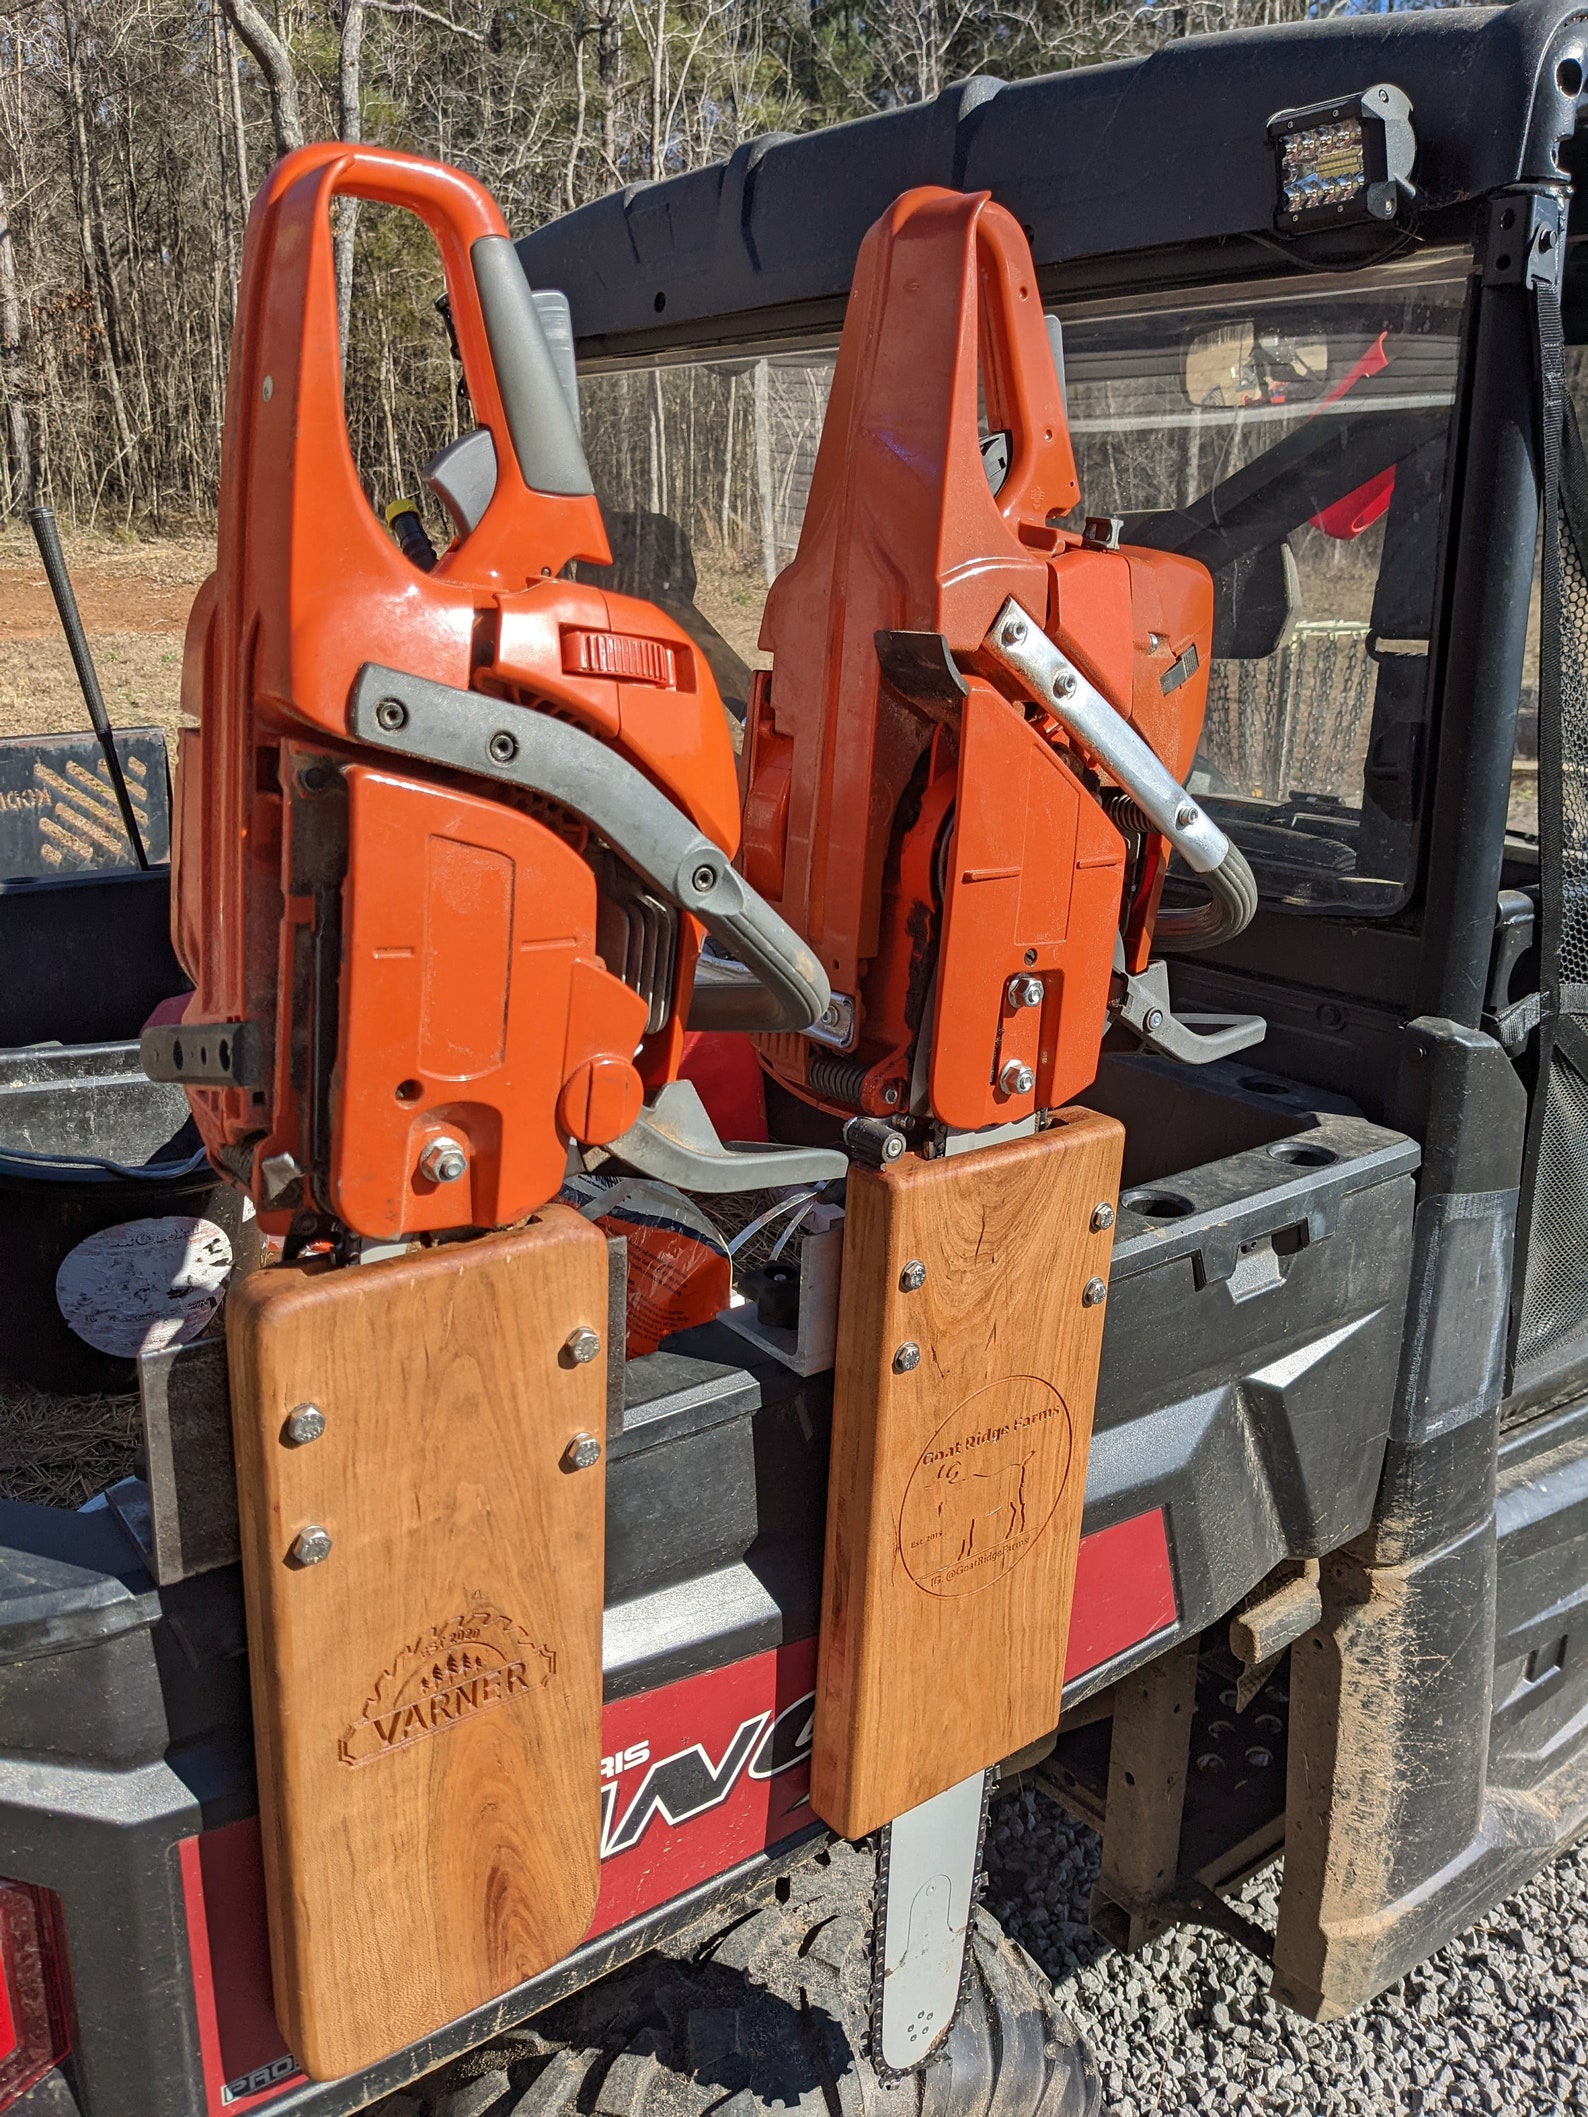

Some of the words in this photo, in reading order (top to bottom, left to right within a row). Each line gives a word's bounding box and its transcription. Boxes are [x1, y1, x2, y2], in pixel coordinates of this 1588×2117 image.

[923, 1441, 961, 1466] Goat
[965, 1426, 1009, 1450] Ridge
[1013, 1405, 1060, 1432] Farms
[449, 1628, 481, 1643] 2020
[373, 1662, 528, 1745] VARNER
